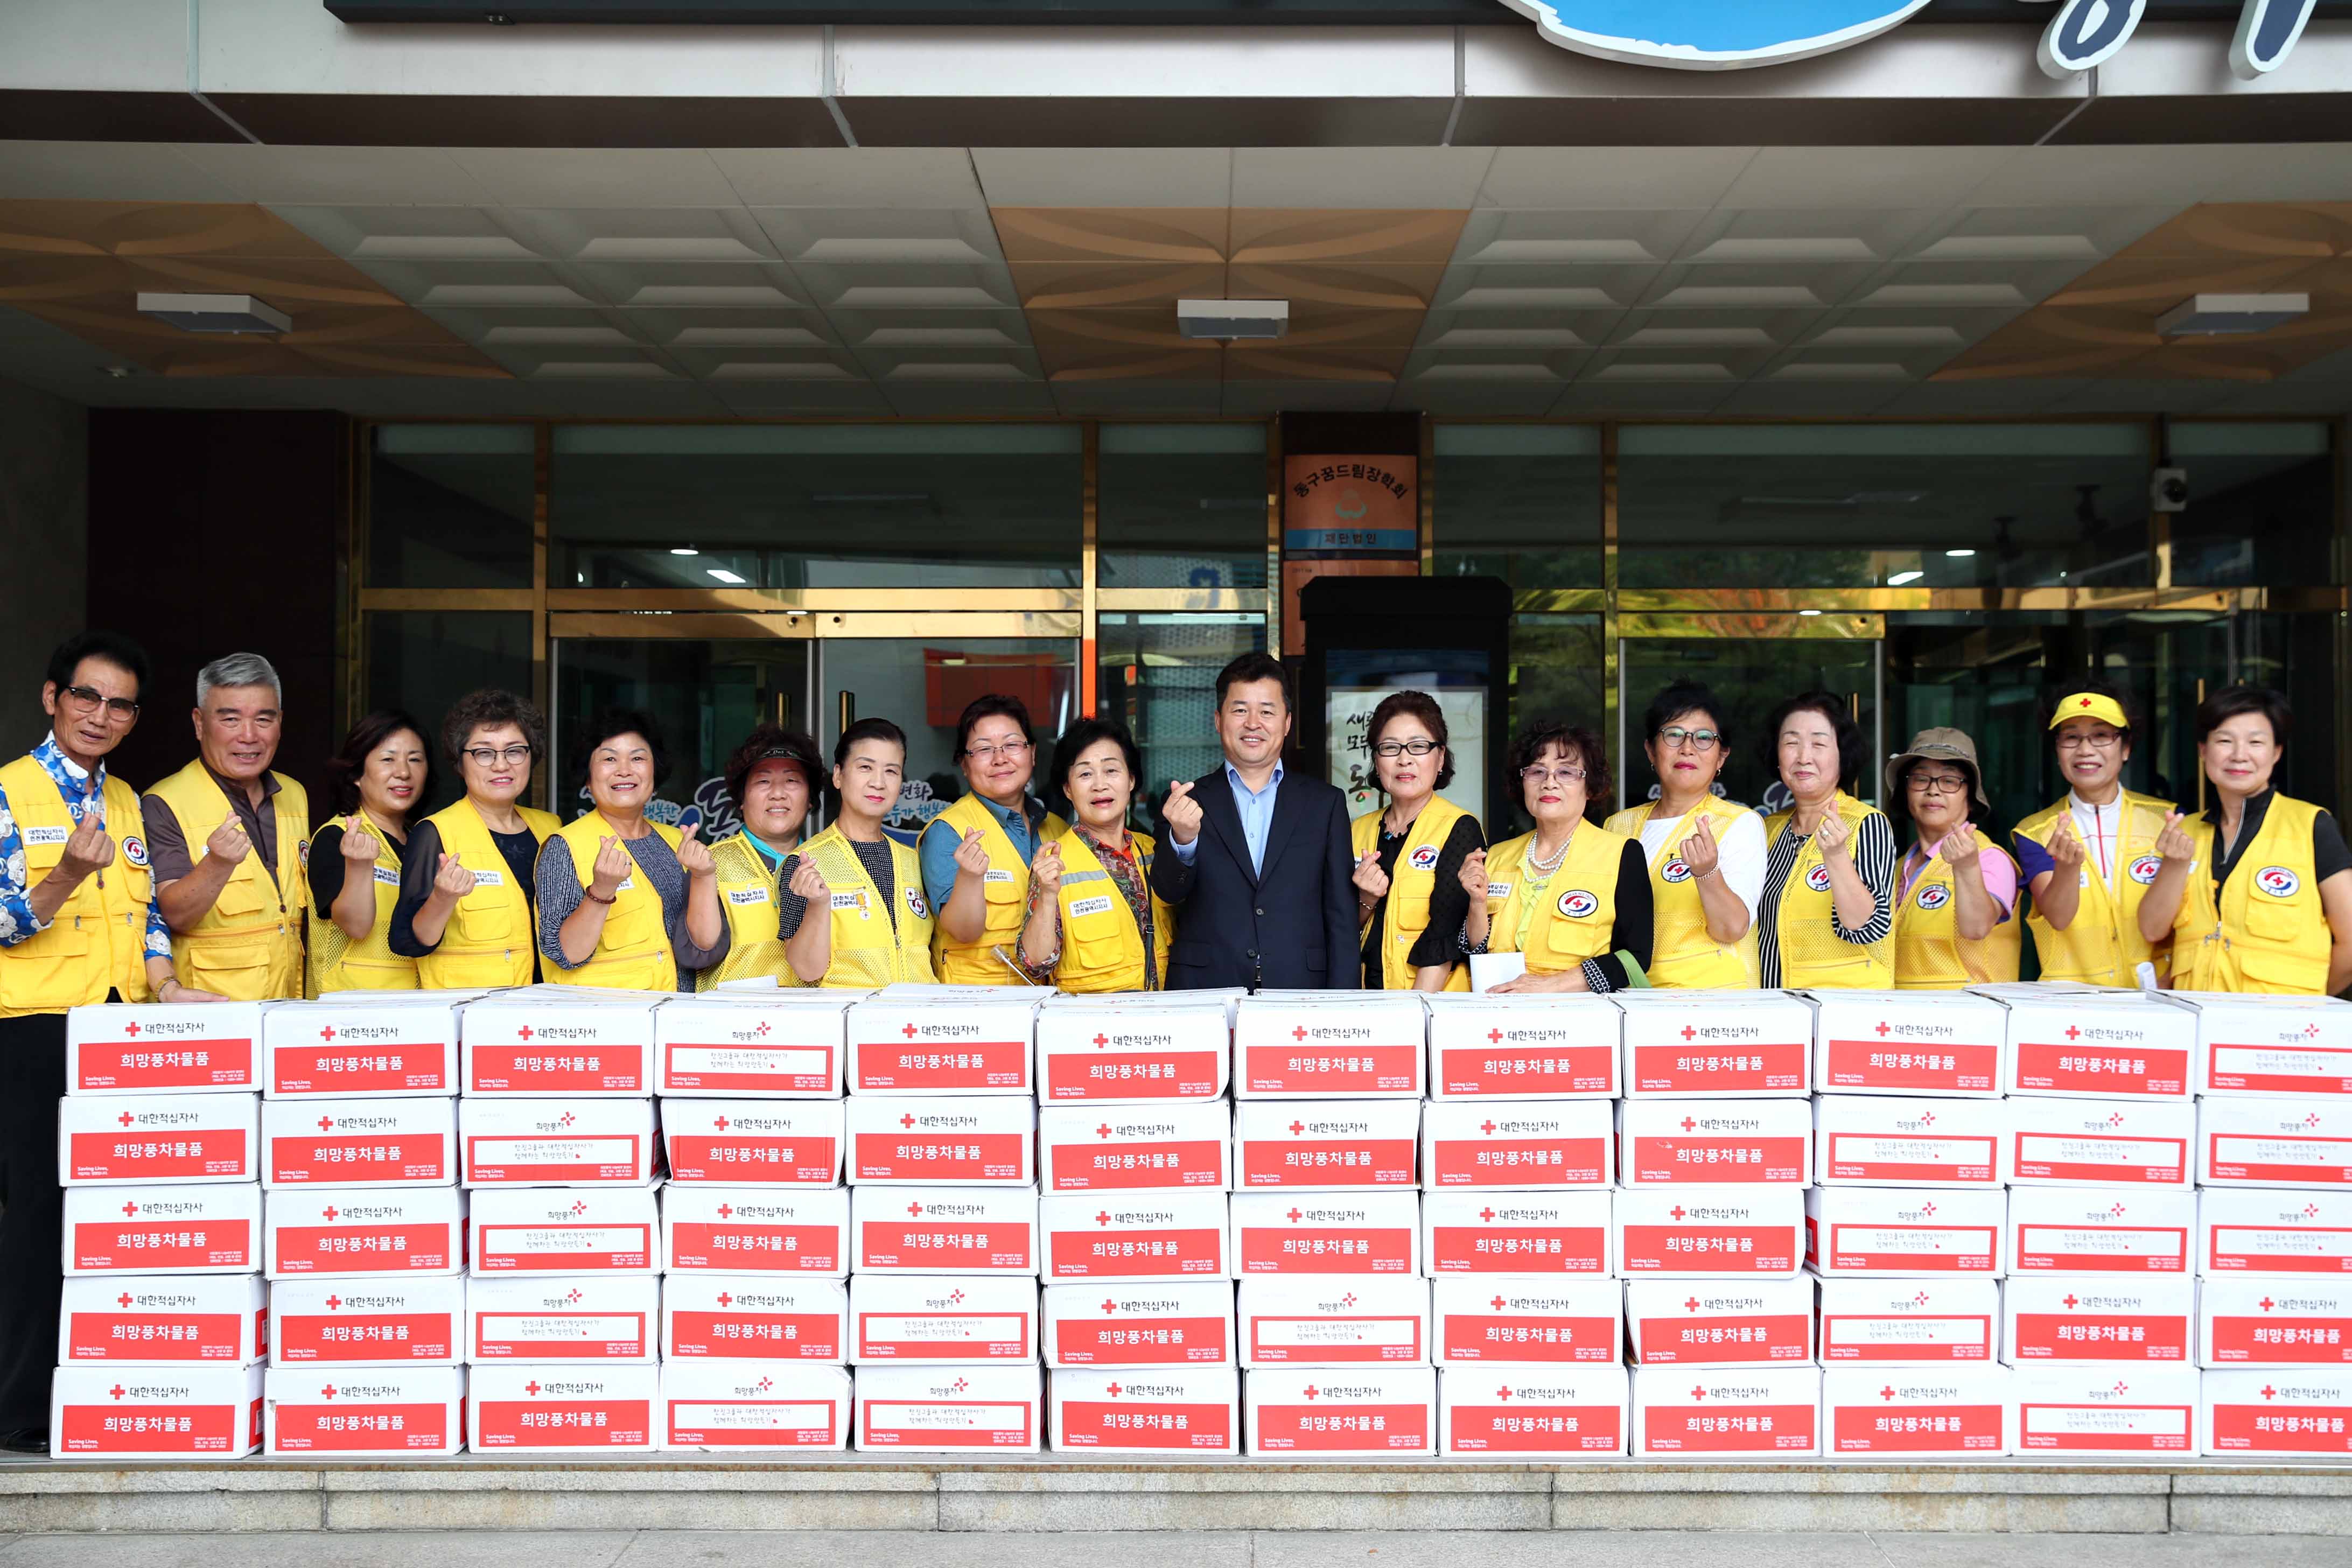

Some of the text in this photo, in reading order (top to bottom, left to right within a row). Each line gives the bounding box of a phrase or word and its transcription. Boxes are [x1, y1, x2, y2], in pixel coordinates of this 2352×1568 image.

[1293, 464, 1408, 499] 동구꿈드림장학회
[145, 1023, 205, 1034] 대한적십자사
[340, 1027, 398, 1038] 대한적십자사
[538, 1028, 597, 1038] 대한적십자사
[921, 1025, 979, 1035] 대한적십자사
[1312, 1028, 1370, 1038] 대한적십자사
[1700, 1027, 1759, 1038] 대한적십자사
[1895, 1025, 1952, 1036] 대한적십자사
[2085, 1029, 2143, 1039] 대한적십자사
[732, 1032, 759, 1040] 희망풍차
[1113, 1035, 1171, 1046] 대한적십자사
[1508, 1030, 1566, 1040] 대한적십자사
[121, 1052, 209, 1068] 희망풍차물품
[316, 1056, 403, 1072] 희망풍차물품
[514, 1057, 600, 1071] 희망풍차물품
[899, 1054, 984, 1069] 희망풍차물품
[1288, 1058, 1374, 1072] 희망풍차물품
[1677, 1056, 1763, 1072] 희망풍차물품
[1870, 1053, 1956, 1070] 희망풍차물품
[2059, 1056, 2146, 1074] 희망풍차물품
[1090, 1064, 1175, 1079] 희망풍차물품
[1483, 1059, 1570, 1074] 희망풍차물품
[138, 1113, 198, 1124] 대한적십자사
[338, 1118, 396, 1128] 대한적십자사
[733, 1119, 791, 1129] 대한적십자사
[920, 1116, 977, 1126] 대한적십자사
[1700, 1119, 1759, 1129] 대한적십자사
[536, 1123, 564, 1131] 희망풍차
[1116, 1125, 1174, 1136] 대한적십자사
[1309, 1123, 1368, 1133] 대한적십자사
[1500, 1122, 1559, 1132] 대한적십자사
[114, 1142, 202, 1158] 희망풍차물품
[314, 1146, 401, 1162] 희망풍차물품
[709, 1147, 794, 1162] 희망풍차물품
[896, 1145, 981, 1159] 희망풍차물품
[1094, 1153, 1179, 1169] 희망풍차물품
[1285, 1152, 1371, 1166] 희망풍차물품
[1476, 1150, 1563, 1166] 희망풍차물품
[1676, 1149, 1763, 1163] 희망풍차물품
[142, 1203, 202, 1214] 대한적십자사
[342, 1207, 402, 1218] 대한적십자사
[737, 1206, 794, 1217] 대한적십자사
[927, 1205, 984, 1215] 대한적십자사
[1690, 1208, 1749, 1219] 대한적십자사
[548, 1212, 576, 1220] 희망풍차
[1115, 1213, 1173, 1223] 대한적십자사
[1306, 1210, 1365, 1220] 대한적십자사
[1499, 1209, 1558, 1220] 대한적십자사
[117, 1233, 207, 1248] 희망풍차물품
[319, 1236, 407, 1252] 희망풍차물품
[713, 1235, 797, 1251] 희망풍차물품
[903, 1234, 989, 1248] 희망풍차물품
[1475, 1238, 1562, 1253] 희망풍차물품
[1665, 1237, 1753, 1252] 희망풍차물품
[1093, 1242, 1178, 1257] 희망풍차물품
[1283, 1240, 1369, 1254] 희망풍차물품
[137, 1295, 195, 1306] 대한적십자사
[346, 1297, 404, 1307] 대한적십자사
[543, 1299, 571, 1308] 희망풍차
[737, 1295, 794, 1306] 대한적십자사
[926, 1300, 954, 1308] 희망풍차
[1510, 1299, 1569, 1309] 대한적십자사
[1704, 1299, 1762, 1309] 대한적십자사
[2083, 1297, 2140, 1307] 대한적십자사
[2279, 1300, 2336, 1309] 대한적십자사
[1121, 1301, 1179, 1312] 대한적십자사
[1318, 1303, 1346, 1312] 희망풍차
[112, 1325, 198, 1340] 희망풍차물품
[322, 1326, 409, 1341] 희망풍차물품
[712, 1324, 797, 1339] 희망풍차물품
[1098, 1329, 1184, 1345] 희망풍차물품
[1486, 1327, 1572, 1342] 희망풍차물품
[1681, 1327, 1767, 1343] 희망풍차물품
[2057, 1326, 2145, 1341] 희망풍차물품
[2253, 1328, 2340, 1343] 희망풍차물품
[129, 1387, 189, 1397] 대한적십자사
[341, 1387, 400, 1397] 대한적십자사
[545, 1383, 603, 1393] 대한적십자사
[735, 1387, 762, 1396] 희망풍차
[930, 1388, 957, 1396] 희망풍차
[1126, 1385, 1184, 1396] 대한적십자사
[1323, 1387, 1381, 1397] 대한적십자사
[1517, 1388, 1575, 1398] 대한적십자사
[1711, 1388, 1768, 1398] 대한적십자사
[1899, 1388, 1957, 1398] 대한적십자사
[2280, 1388, 2339, 1398] 대한적십자사
[104, 1417, 192, 1432] 희망풍차물품
[317, 1416, 404, 1430] 희망풍차물품
[521, 1412, 607, 1427] 희망풍차물품
[1103, 1413, 1188, 1429] 희망풍차물품
[1299, 1416, 1385, 1431] 희망풍차물품
[1492, 1417, 1579, 1432] 희망풍차물품
[1686, 1417, 1773, 1432] 희망풍차물품
[1875, 1417, 1962, 1432] 희망풍차물품
[2256, 1417, 2344, 1432] 희망풍차물품
